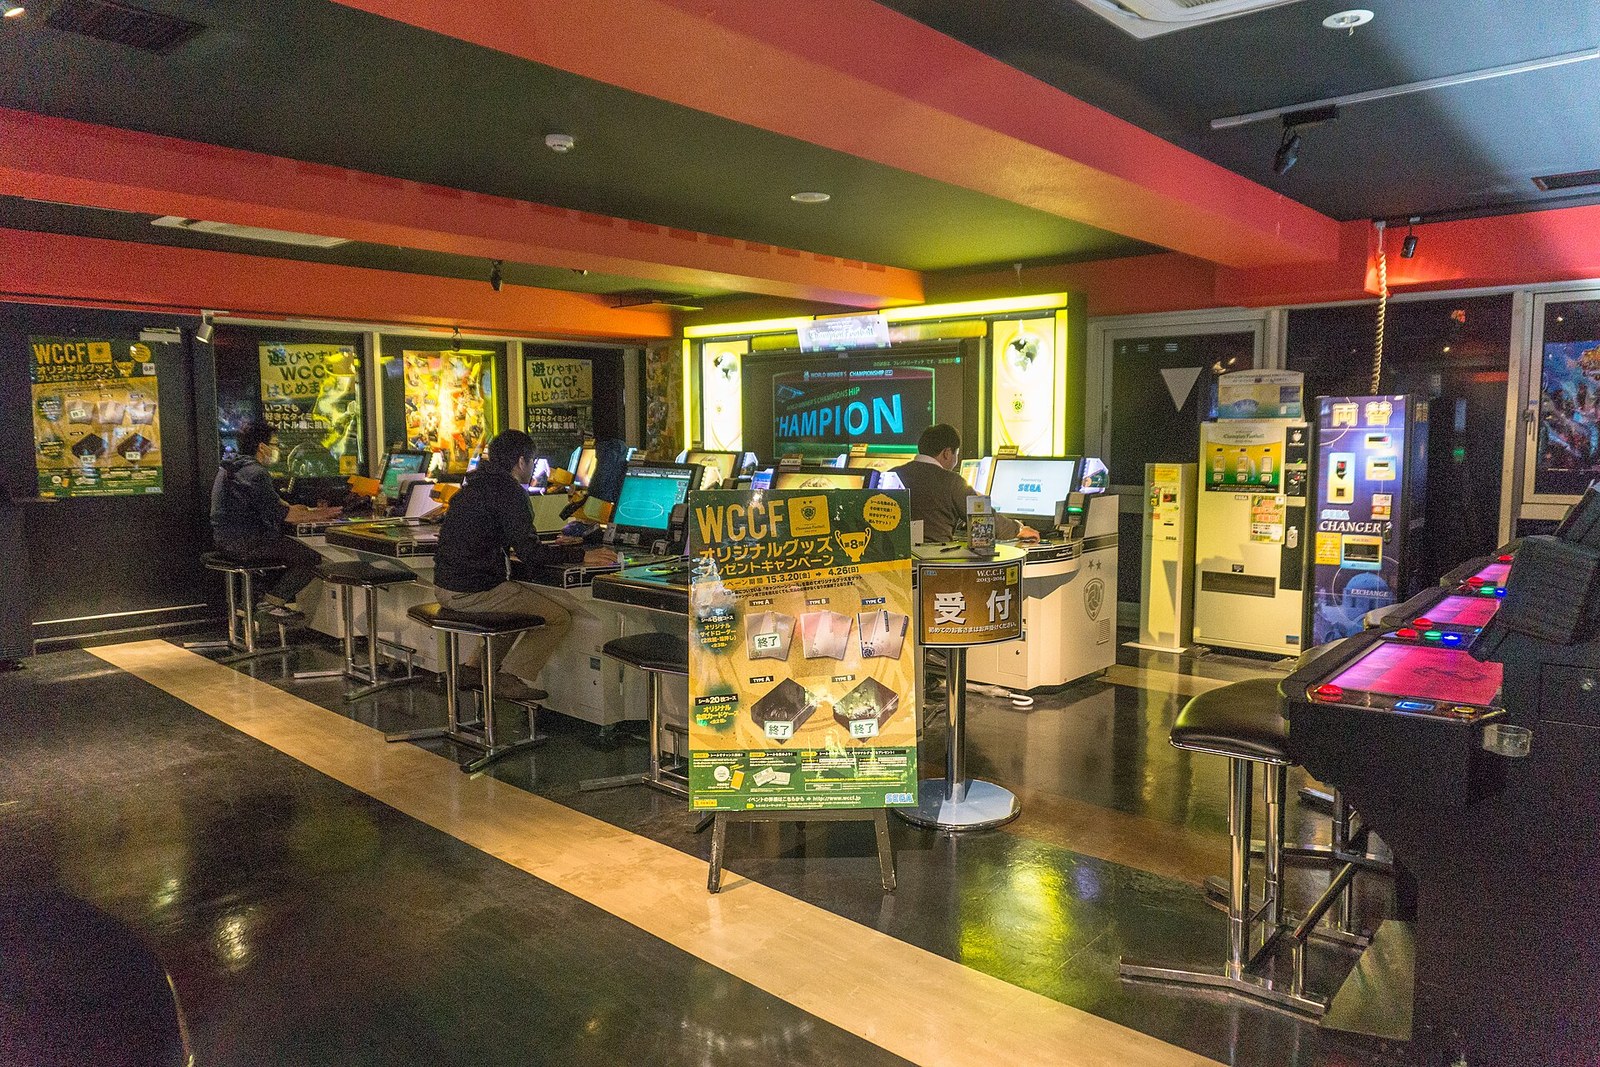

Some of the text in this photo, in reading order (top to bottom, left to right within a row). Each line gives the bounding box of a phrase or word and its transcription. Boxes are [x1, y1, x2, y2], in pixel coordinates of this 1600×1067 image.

[33, 342, 87, 364] WCCF
[532, 362, 583, 377] 遊びやすい
[849, 369, 885, 377] CHAMPIONSHIP
[541, 375, 577, 389] WCCF
[1332, 401, 1393, 427] 両替
[1018, 483, 1041, 492] SEGA
[696, 499, 785, 545] WCCF
[1319, 520, 1381, 534] CHANGER
[699, 536, 834, 563] オリジナルグッズ
[976, 568, 1005, 577] W.C.C.F.
[1351, 588, 1389, 597] EXCHANGE
[757, 635, 779, 648] 終了
[703, 704, 731, 713] オリジナル
[768, 723, 790, 736] 終了
[852, 722, 875, 735] 終了
[884, 792, 914, 805] SEGA
